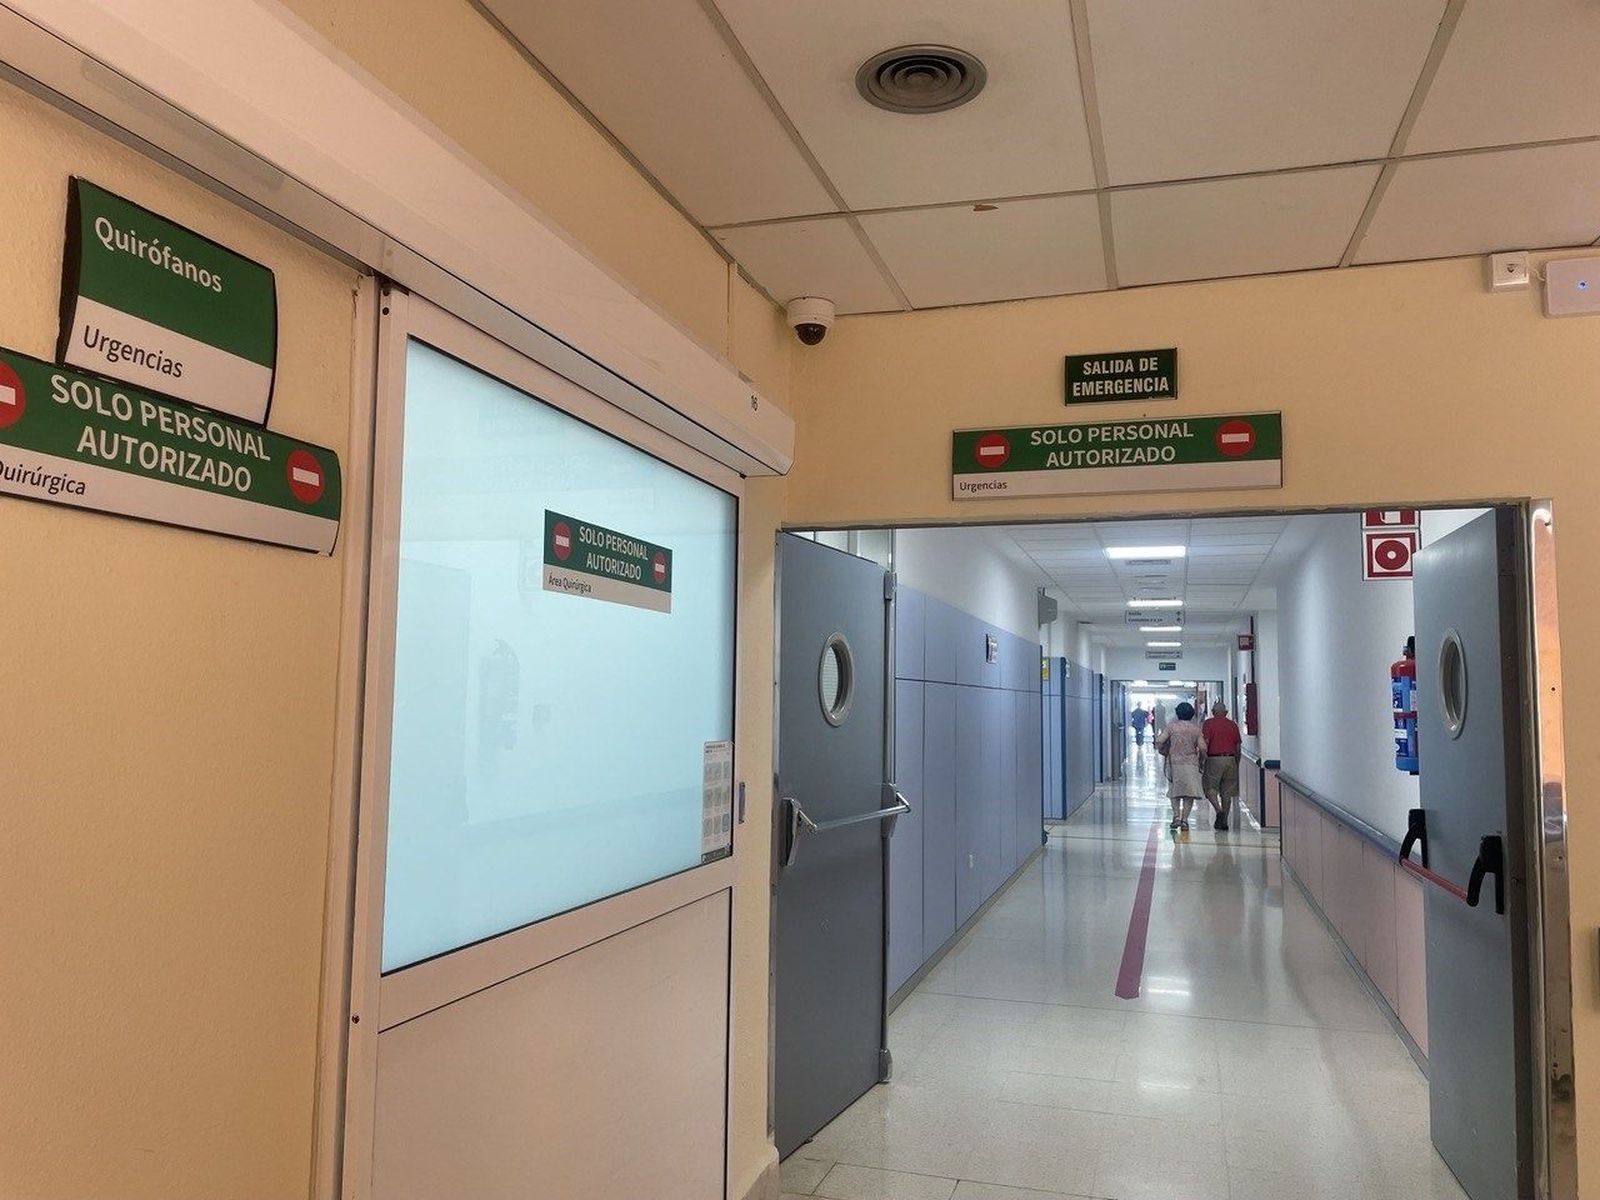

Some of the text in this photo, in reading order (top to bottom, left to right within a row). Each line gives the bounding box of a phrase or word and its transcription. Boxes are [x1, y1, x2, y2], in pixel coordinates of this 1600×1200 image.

[95, 216, 223, 293] Quirófanos
[83, 325, 183, 378] Urgencias
[1083, 357, 1159, 376] SALIDA DE
[1073, 377, 1169, 397] EMERGENCIA
[50, 374, 271, 460] SOLO PERSONAL
[1030, 422, 1194, 446] SOLO PERSONAL
[77, 425, 252, 492] AUTORIZADO
[1046, 445, 1176, 468] AUTORIZADO
[959, 479, 1008, 494] Urgencias
[579, 526, 649, 561] SOLO PERSONAL
[586, 552, 642, 580] AUTORIZADO
[548, 572, 592, 595] Área Quirúrgica
